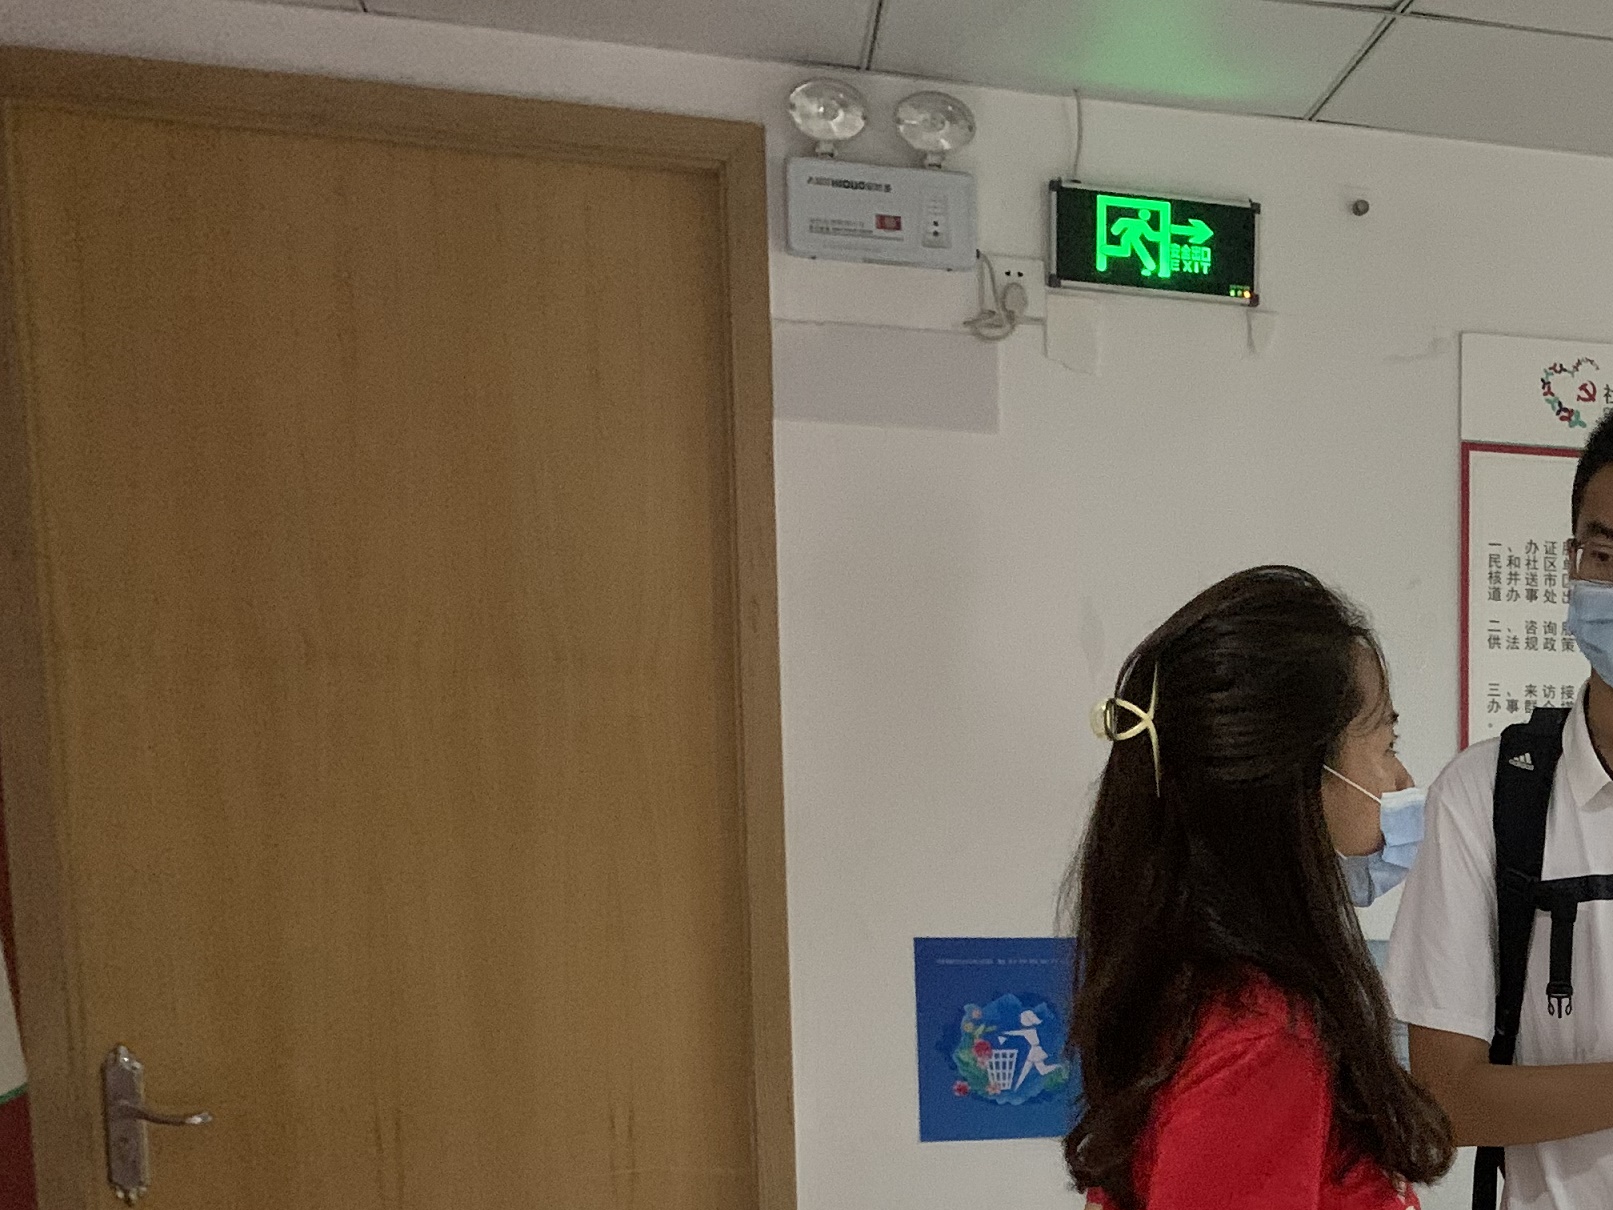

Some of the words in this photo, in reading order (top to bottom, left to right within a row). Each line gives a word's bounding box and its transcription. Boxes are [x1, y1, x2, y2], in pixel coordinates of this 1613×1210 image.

[1171, 260, 1210, 274] EXIT
[1487, 634, 1575, 653] 供法规政策
[1487, 682, 1575, 699] 三、来访接
